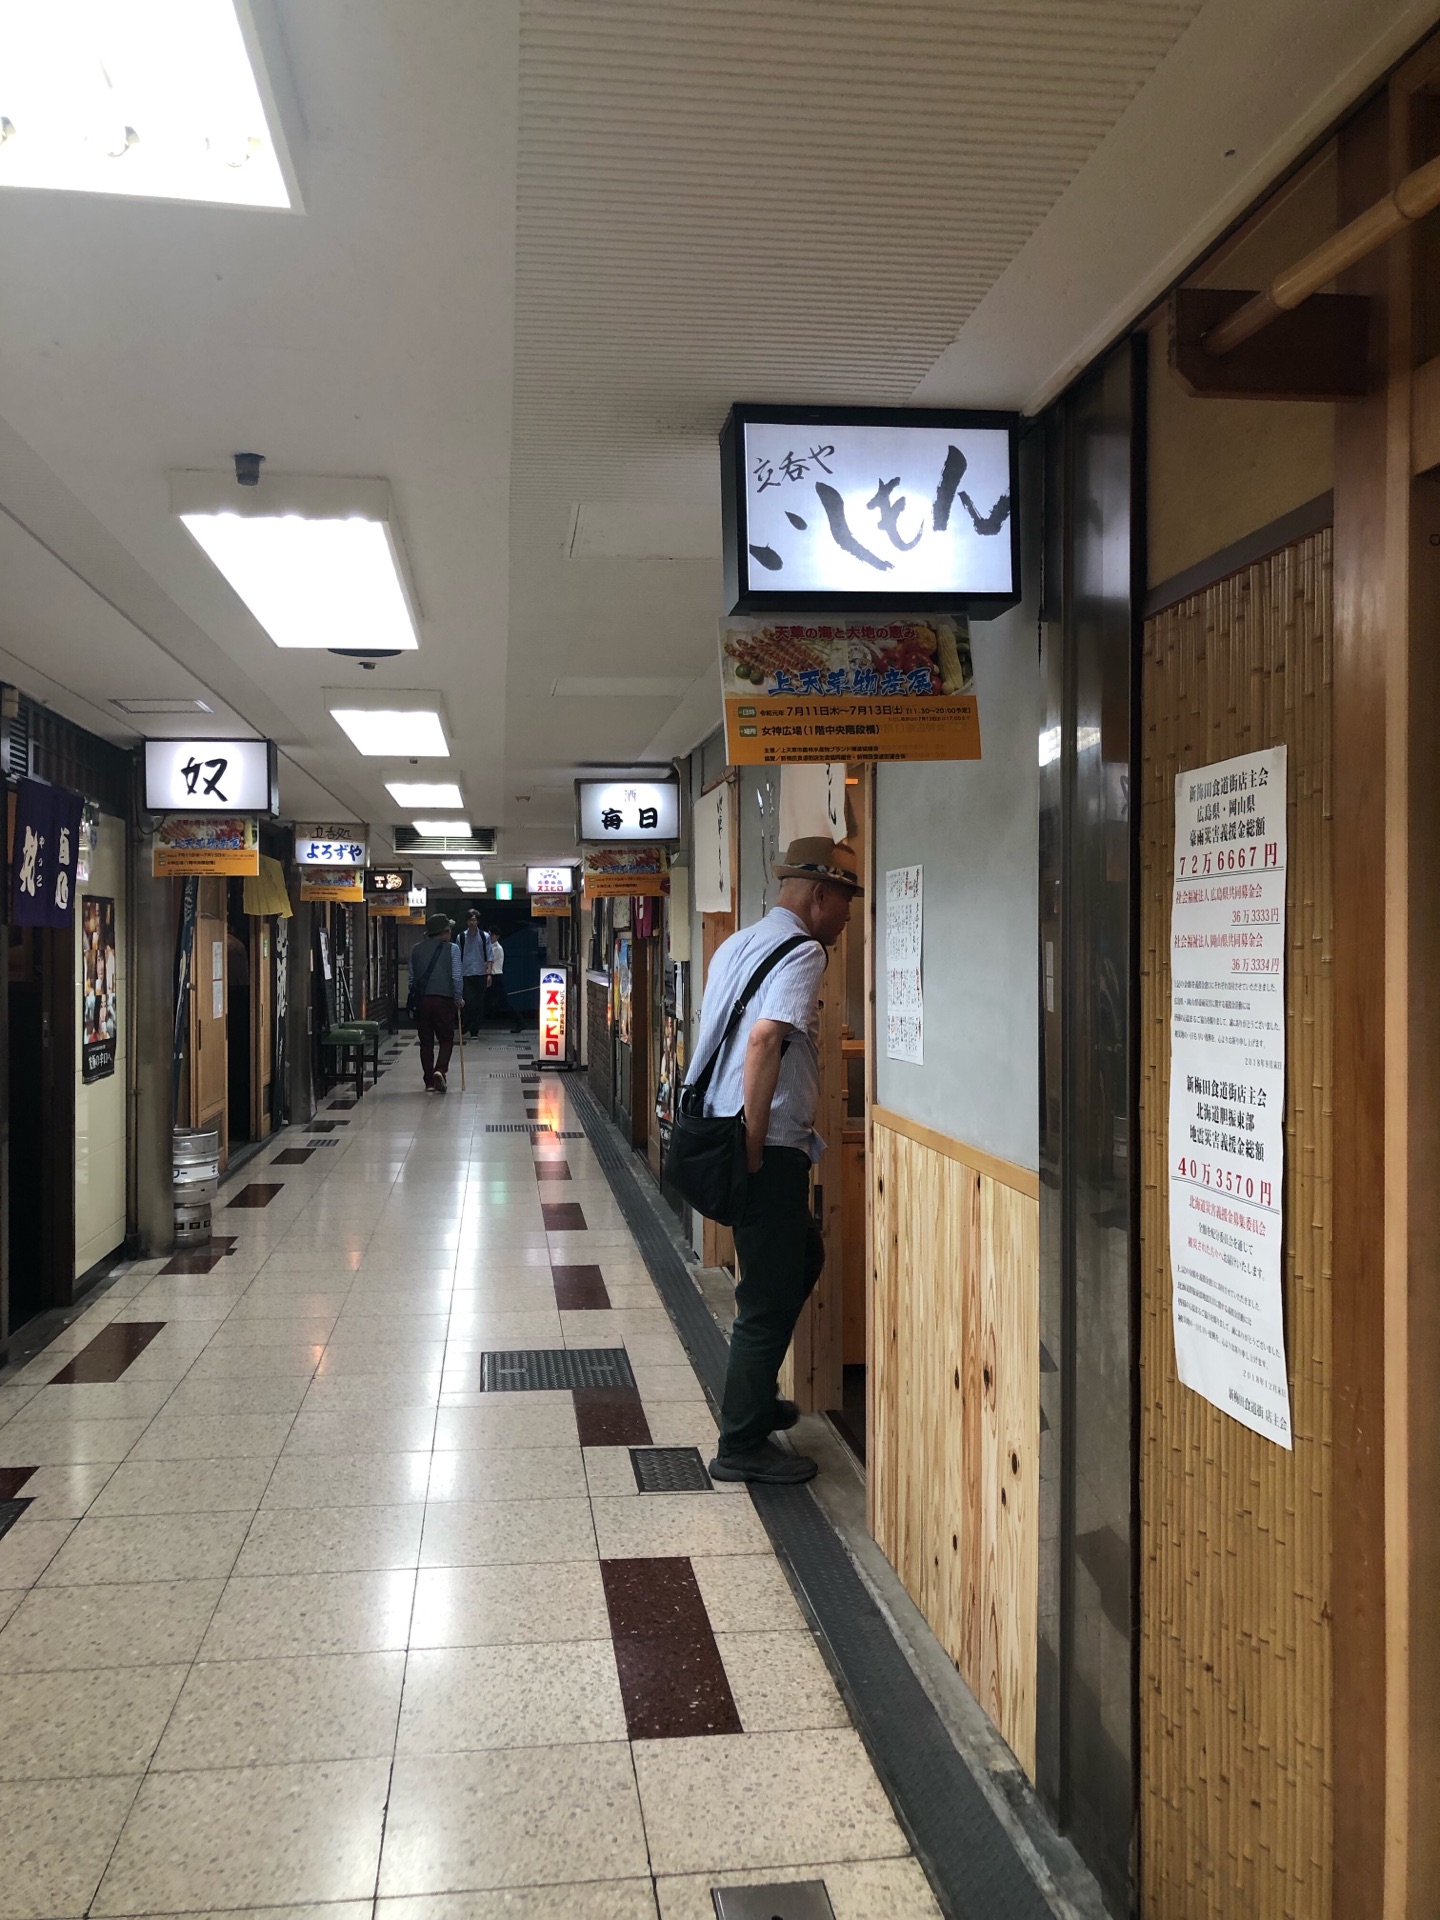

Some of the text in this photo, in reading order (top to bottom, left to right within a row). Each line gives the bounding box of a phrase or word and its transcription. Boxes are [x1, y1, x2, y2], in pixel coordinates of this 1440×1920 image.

[753, 445, 835, 493] 立呑や
[774, 626, 916, 640] 天草の海と大地の恵み
[769, 667, 933, 696] 上天草物産展
[181, 757, 228, 802] 奴
[1189, 767, 1269, 803] 新梅田食道街店主会
[601, 807, 659, 830] 毎日
[1196, 794, 1256, 823] 広島県・岡山県
[1189, 817, 1266, 848] 豪雨災害義援金総額
[306, 842, 363, 862] よろずや
[1179, 842, 1278, 876] 72万6667円
[1176, 884, 1263, 904] 社会福祉法人広島県共同募金会
[1231, 907, 1280, 924] 36万3333円
[1174, 932, 1263, 949] 社会福祉法人岡山県共同募金会
[1231, 957, 1280, 973] 36万3334円
[545, 989, 560, 1056] スエヒロ
[1186, 1074, 1268, 1108] 新梅田食道街店主会
[1196, 1101, 1255, 1132] 北海道胆振東部
[1189, 1125, 1265, 1162] 地震災害義援金総額
[1178, 1156, 1272, 1206] 40万3570円
